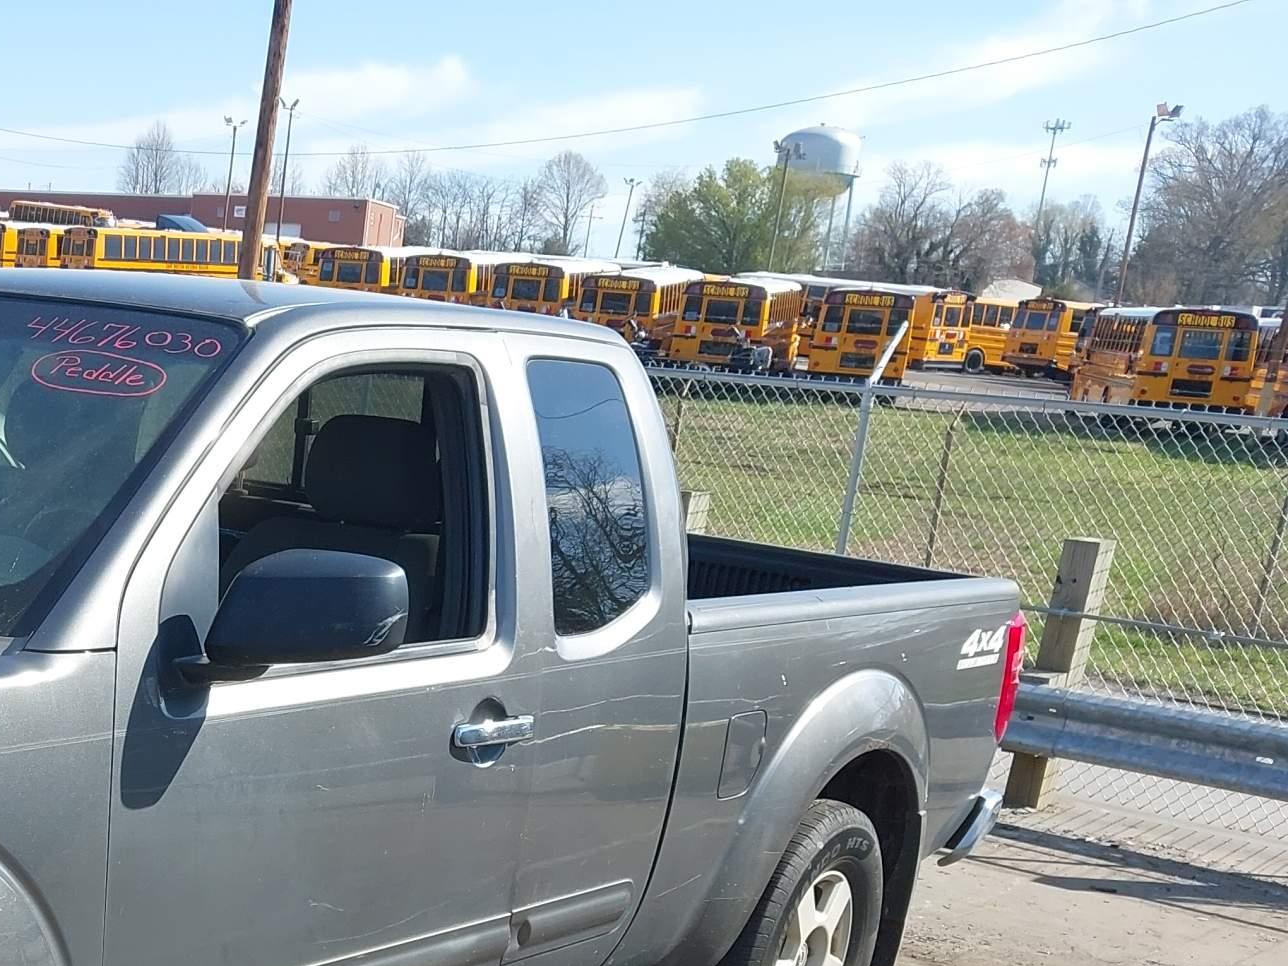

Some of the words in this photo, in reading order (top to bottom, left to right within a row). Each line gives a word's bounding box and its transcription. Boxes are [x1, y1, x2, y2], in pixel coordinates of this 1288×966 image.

[1178, 313, 1213, 327] SCHOOL
[1217, 315, 1236, 328] BUS
[27, 316, 222, 357] 44676030
[49, 355, 145, 386] Peddle
[846, 837, 870, 851] HTS
